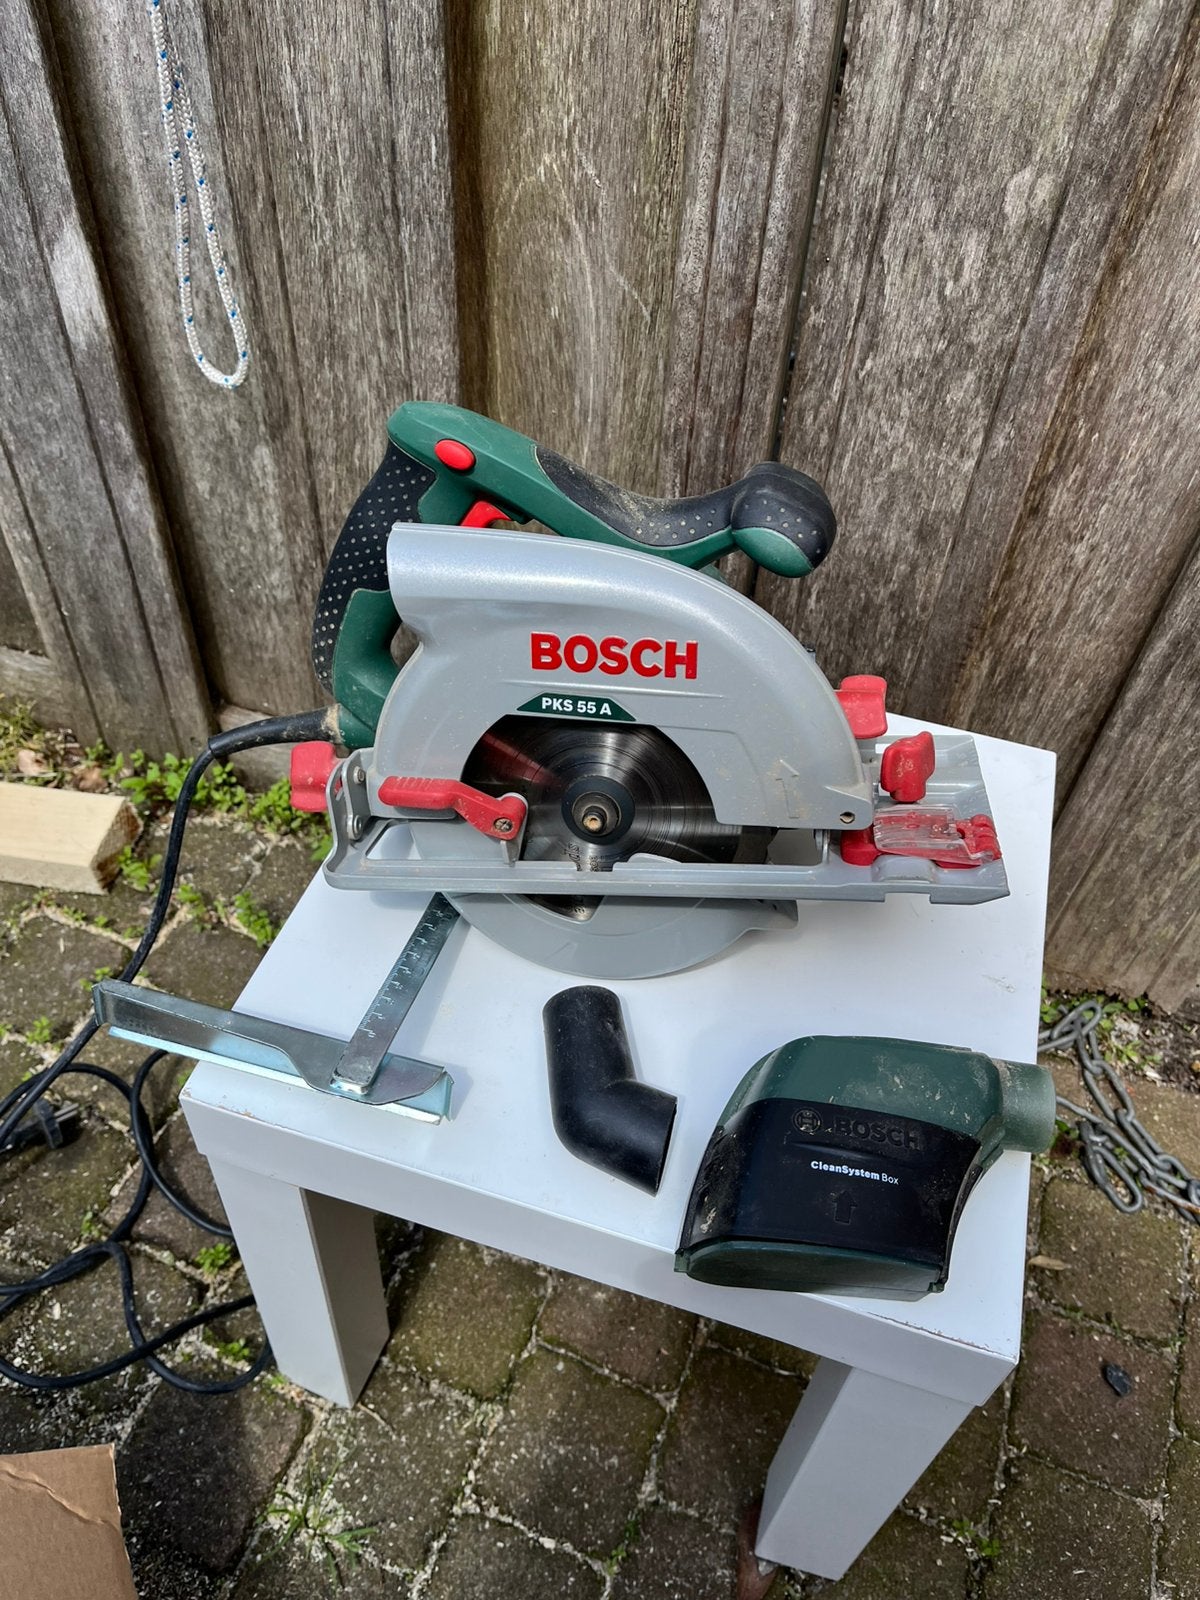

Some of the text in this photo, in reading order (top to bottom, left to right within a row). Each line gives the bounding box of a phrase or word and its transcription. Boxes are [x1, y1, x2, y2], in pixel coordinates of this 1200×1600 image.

[530, 631, 699, 680] BOSCH
[541, 697, 612, 716] PKS 55 A
[833, 1115, 922, 1151] BOSCH
[810, 1160, 899, 1186] CleanSystem Box
